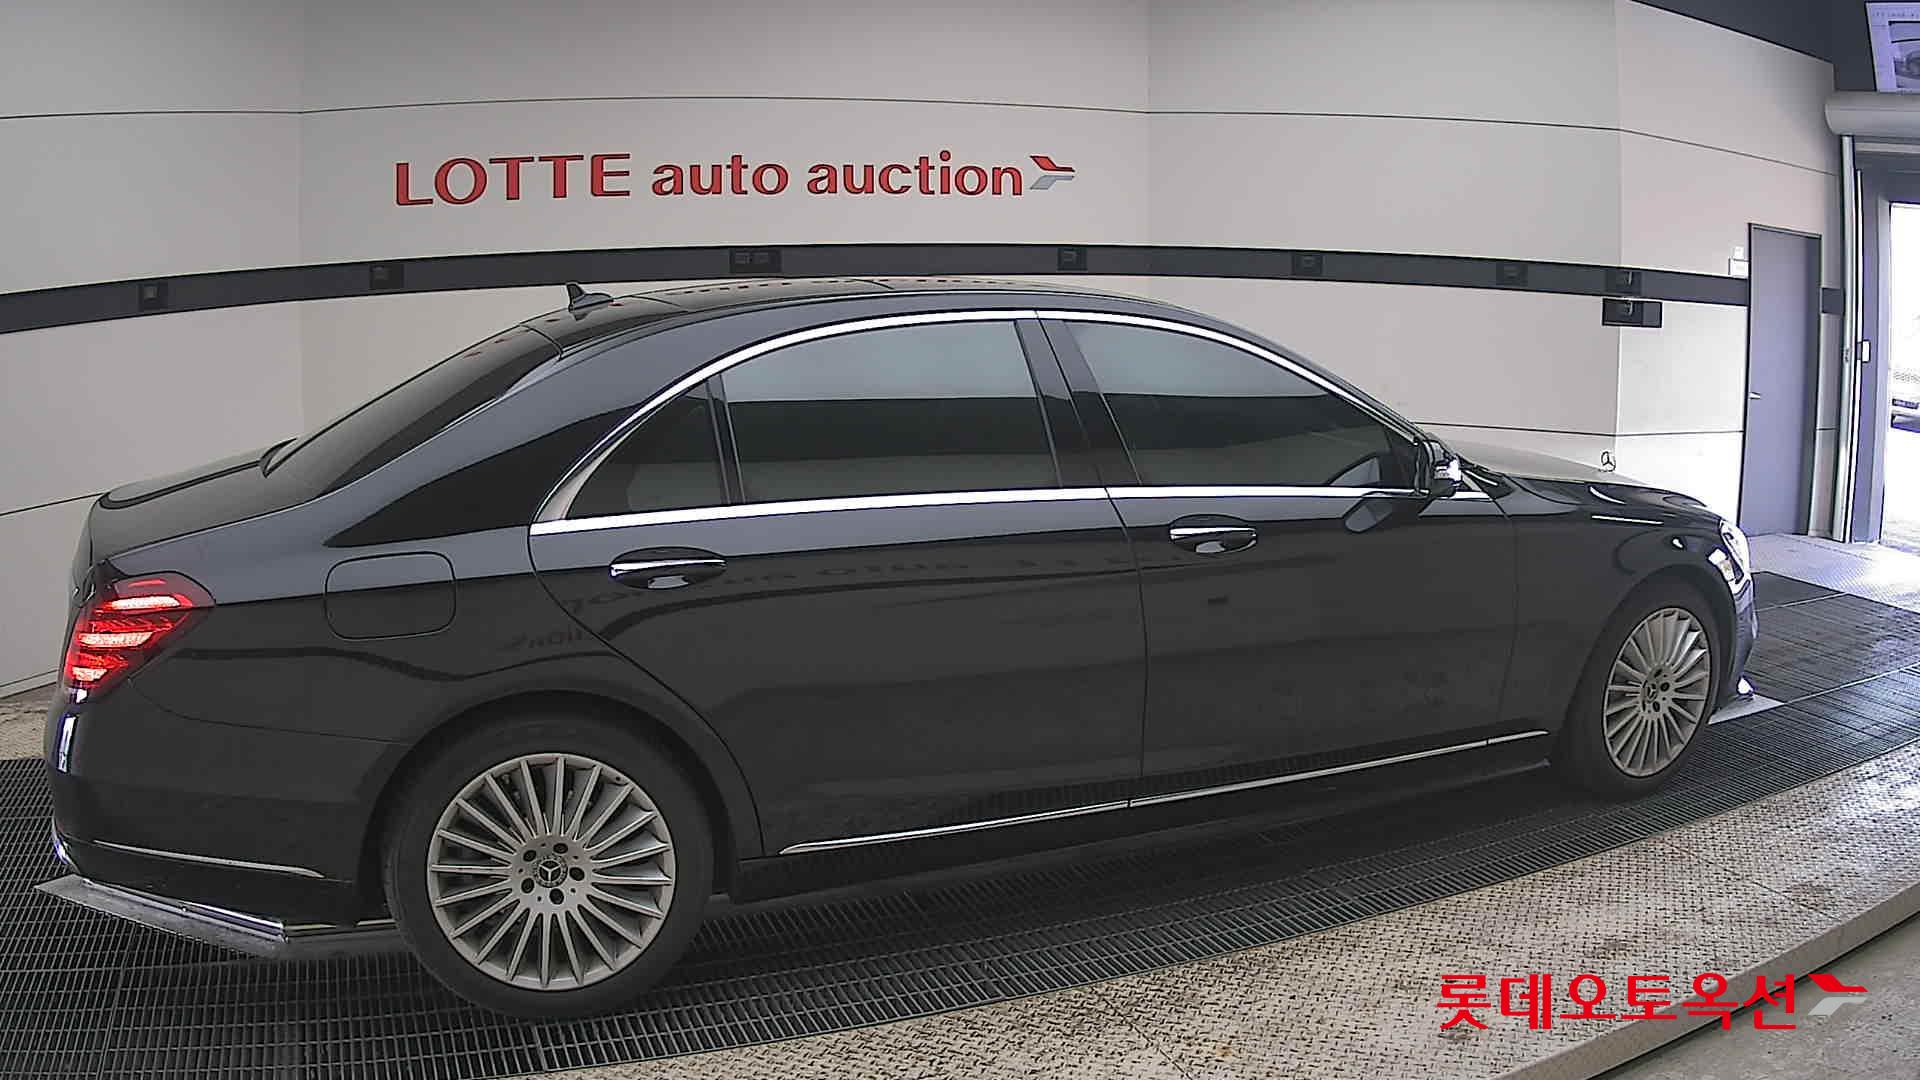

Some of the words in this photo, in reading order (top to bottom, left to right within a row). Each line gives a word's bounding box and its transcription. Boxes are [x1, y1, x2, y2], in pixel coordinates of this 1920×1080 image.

[395, 153, 631, 206] LOTTE
[651, 154, 790, 196] auto
[806, 151, 1024, 196] auction
